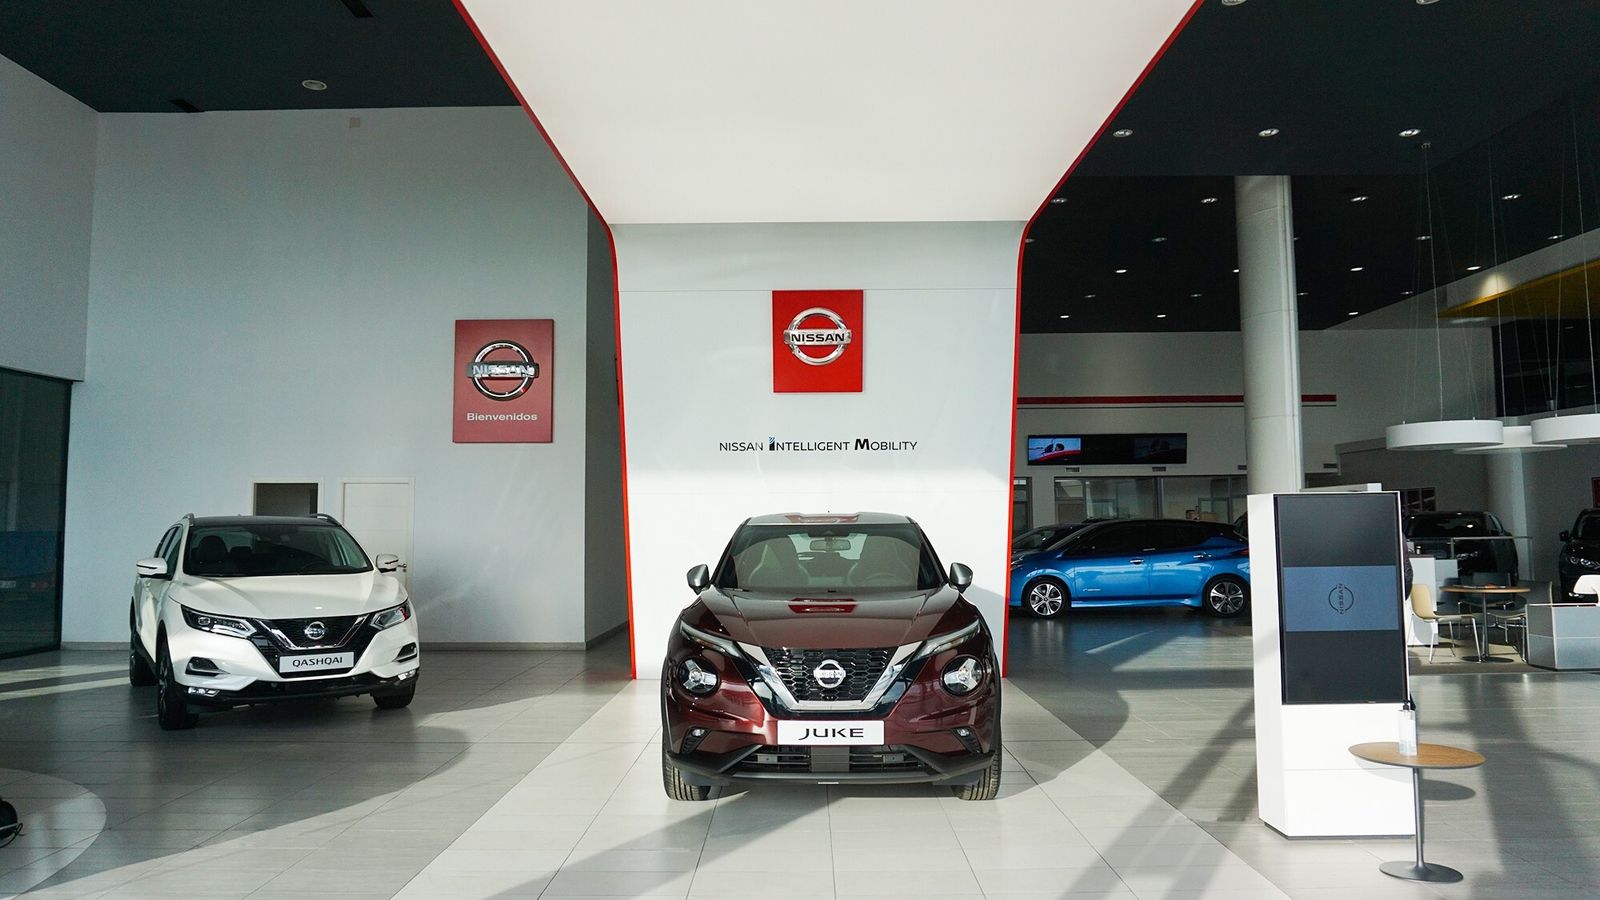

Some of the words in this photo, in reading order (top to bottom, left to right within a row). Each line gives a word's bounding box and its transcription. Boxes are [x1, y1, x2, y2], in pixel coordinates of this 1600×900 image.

[791, 333, 845, 342] NISSAN
[466, 412, 538, 421] Bienvenidos
[719, 442, 764, 452] NISSAN
[854, 438, 918, 451] MOBILITY
[292, 656, 343, 668] QASHQAI
[798, 728, 864, 740] JUKE
